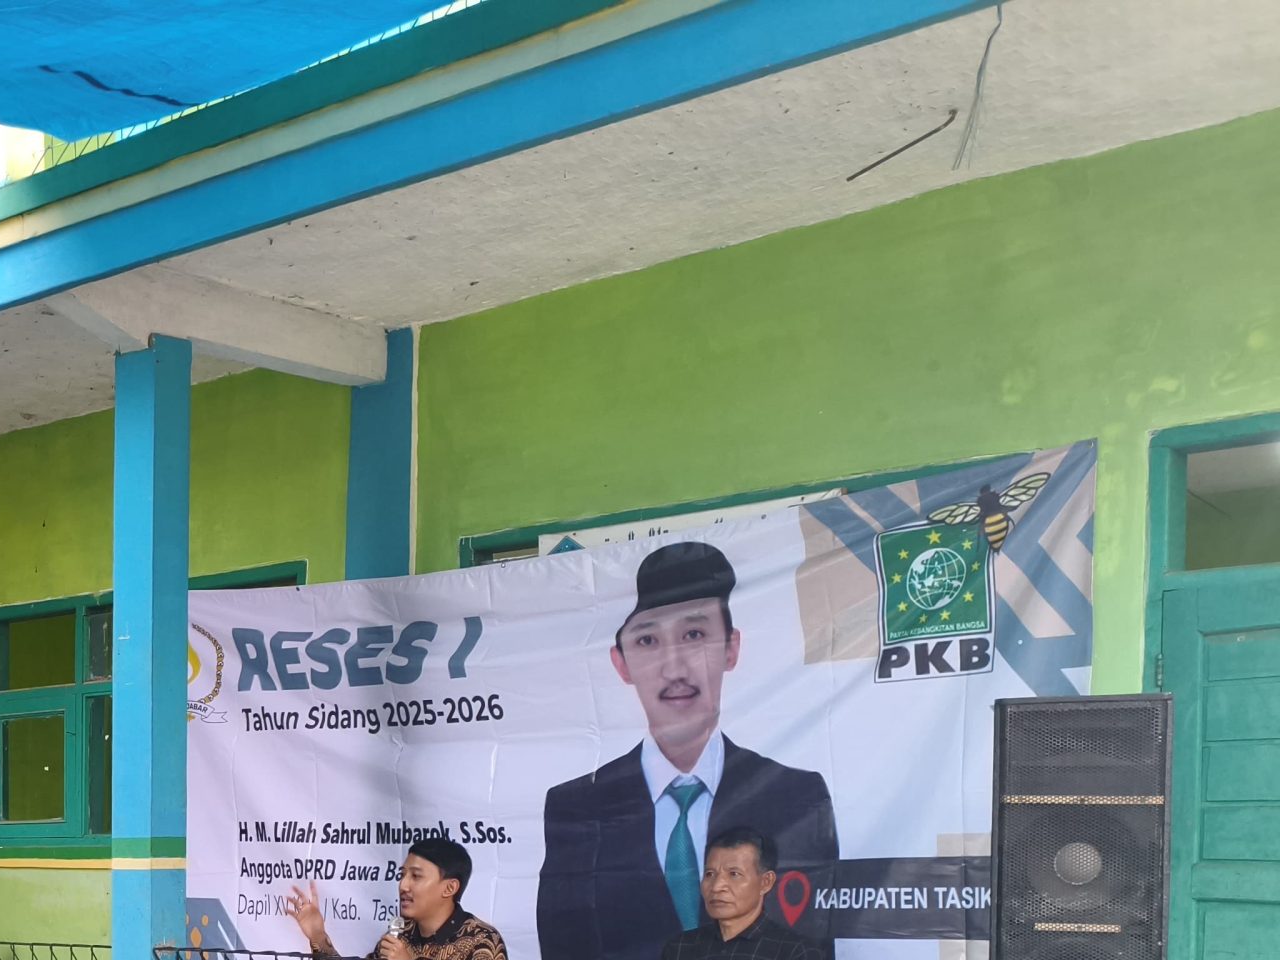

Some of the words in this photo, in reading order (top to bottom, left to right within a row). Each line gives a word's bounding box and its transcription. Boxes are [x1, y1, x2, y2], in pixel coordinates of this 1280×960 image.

[956, 620, 985, 631] BANGSA
[232, 620, 439, 692] RESES
[878, 638, 991, 679] PKB
[241, 706, 299, 732] Tahun
[305, 703, 380, 734] Sidang
[382, 694, 504, 727] 2025-2026
[239, 821, 253, 842] H.
[255, 821, 271, 843] M.
[274, 821, 317, 843] Lillah
[320, 821, 371, 844] Sahrul
[460, 821, 512, 844] S.Sos.
[240, 857, 293, 884] Anggota
[294, 858, 336, 881] DPRD
[340, 860, 380, 881] Jawa
[237, 893, 271, 921] Dapil
[332, 898, 361, 920] Kab.
[815, 886, 928, 909] KABUPATEN
